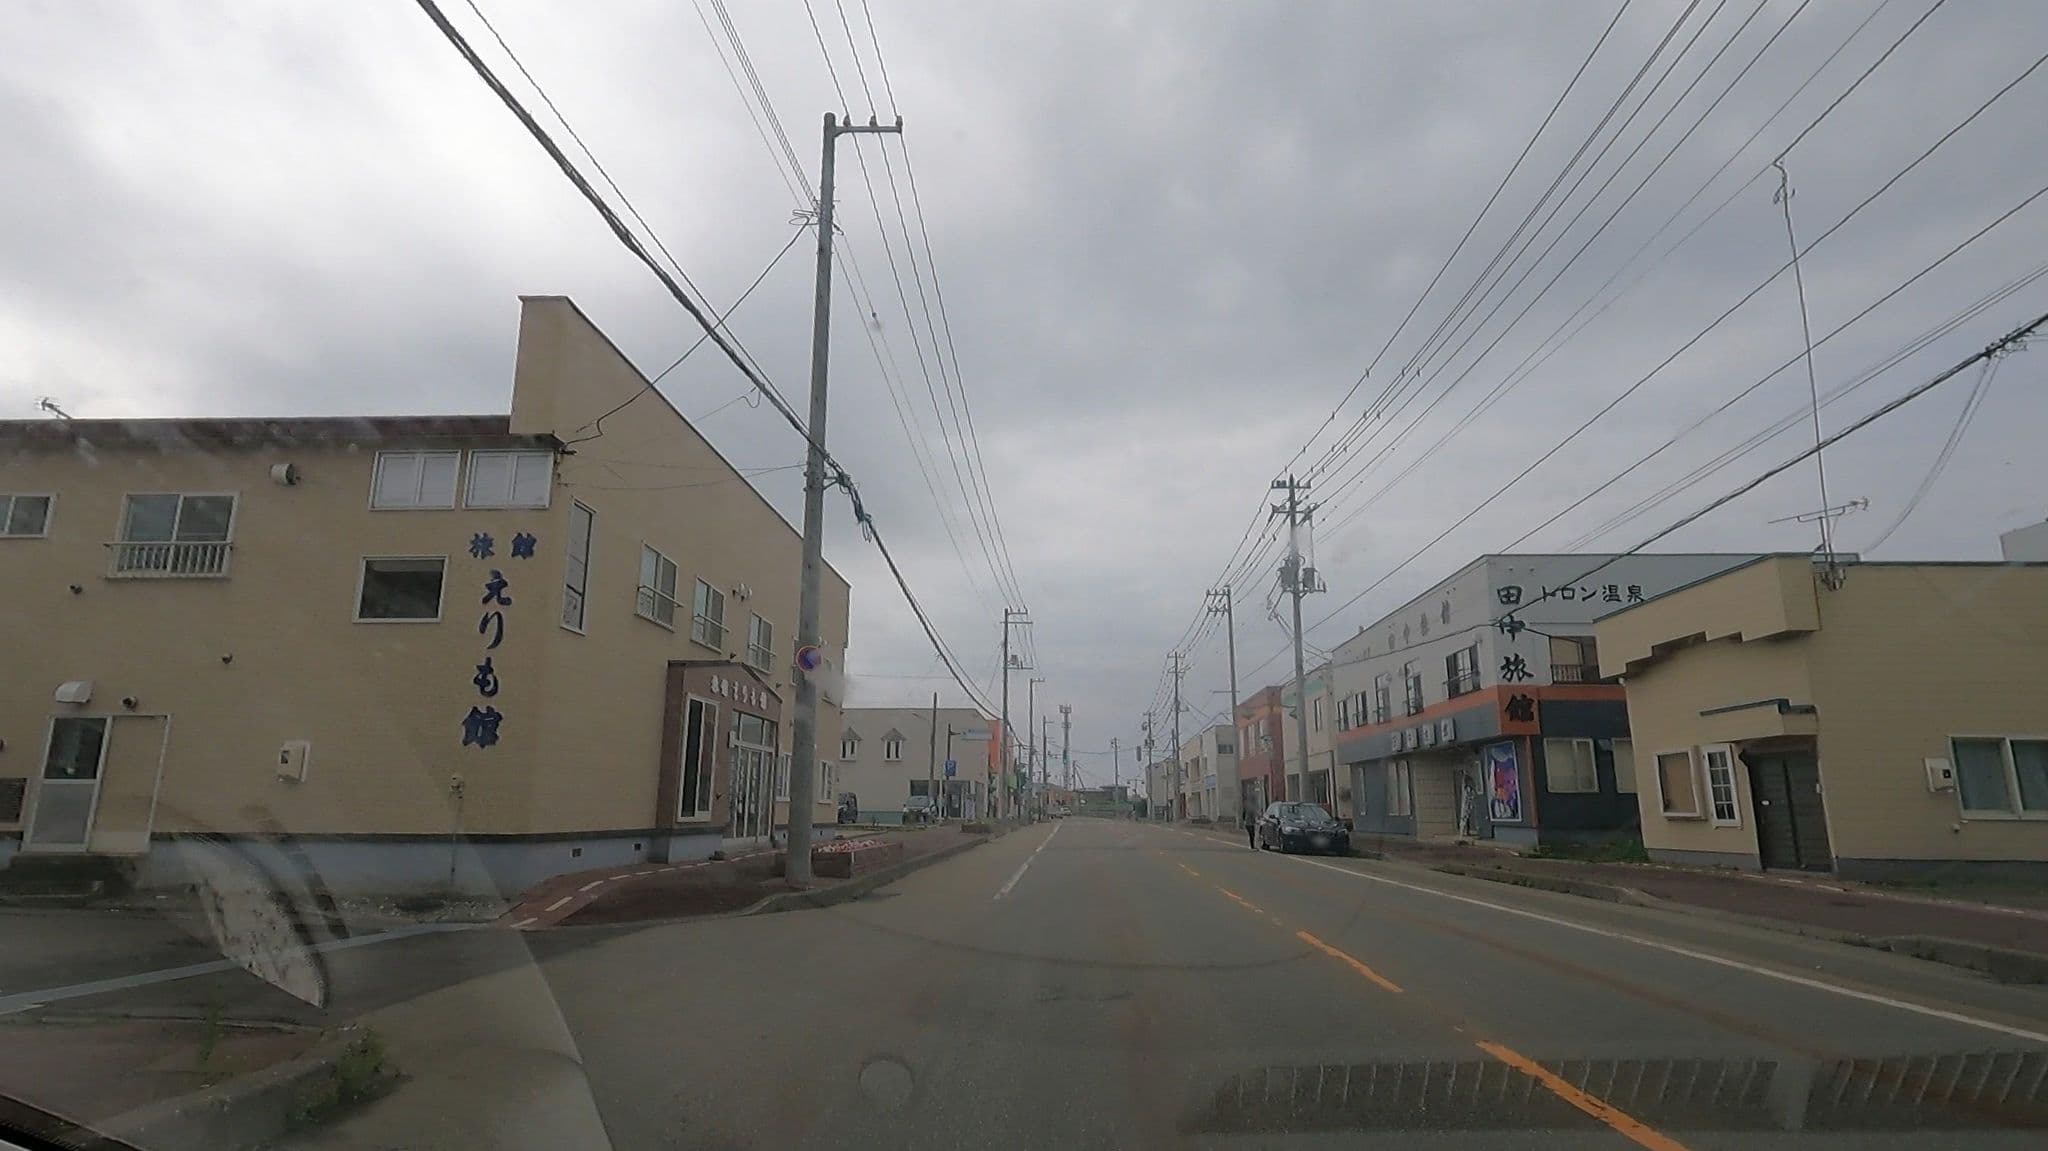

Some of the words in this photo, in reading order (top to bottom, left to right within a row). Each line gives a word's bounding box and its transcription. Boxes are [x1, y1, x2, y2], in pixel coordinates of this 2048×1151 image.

[469, 532, 537, 560] 旅館
[1541, 584, 1645, 603] トロン温泉
[462, 568, 513, 749] えりも館
[1496, 585, 1535, 722] 田中旅館
